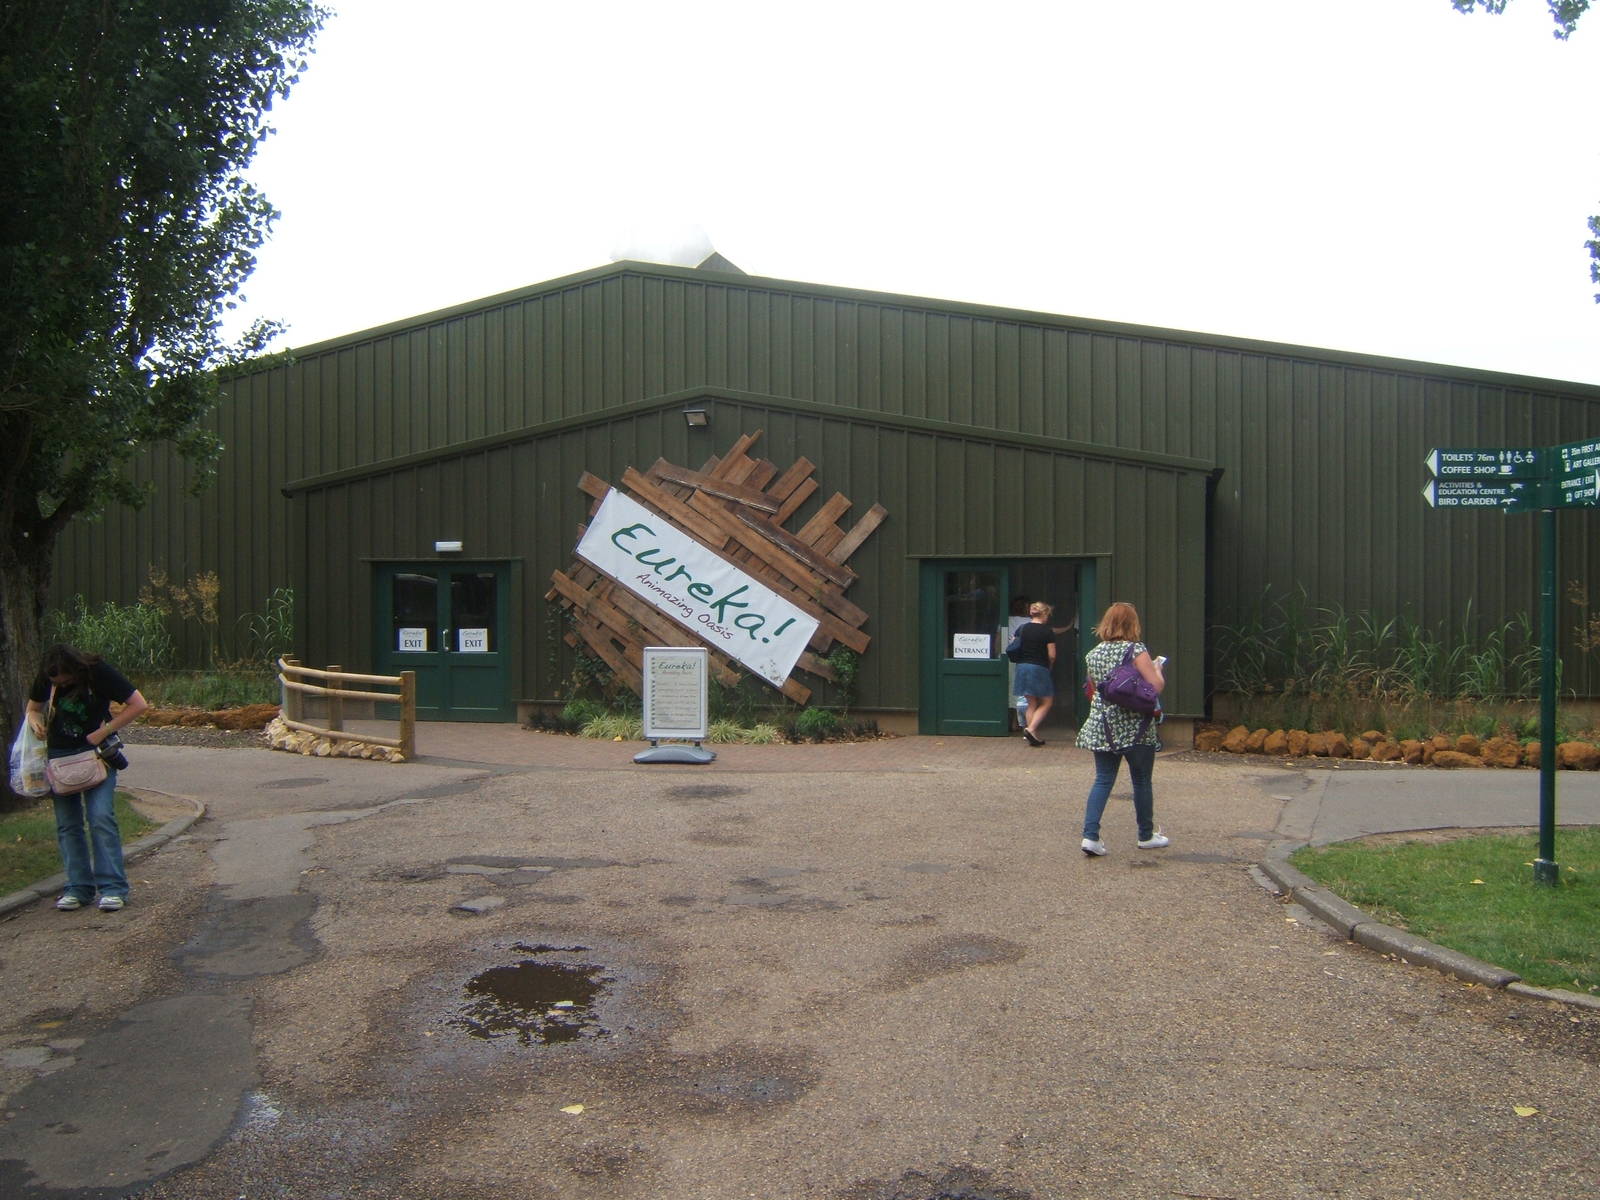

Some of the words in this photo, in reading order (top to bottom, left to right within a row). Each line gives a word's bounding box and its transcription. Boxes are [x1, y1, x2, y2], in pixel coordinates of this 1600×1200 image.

[1441, 453, 1473, 461] TOILETS
[1477, 453, 1495, 461] 76m
[1573, 460, 1582, 468] ART
[1441, 466, 1471, 474] COFFEE
[1474, 466, 1496, 474] SHOP
[611, 523, 796, 644] Eureka!
[636, 573, 694, 618] Animazing
[698, 613, 734, 640] Oasis
[404, 640, 422, 648] EXIT
[464, 640, 482, 648] EXIT
[658, 661, 697, 670] Eureka!
